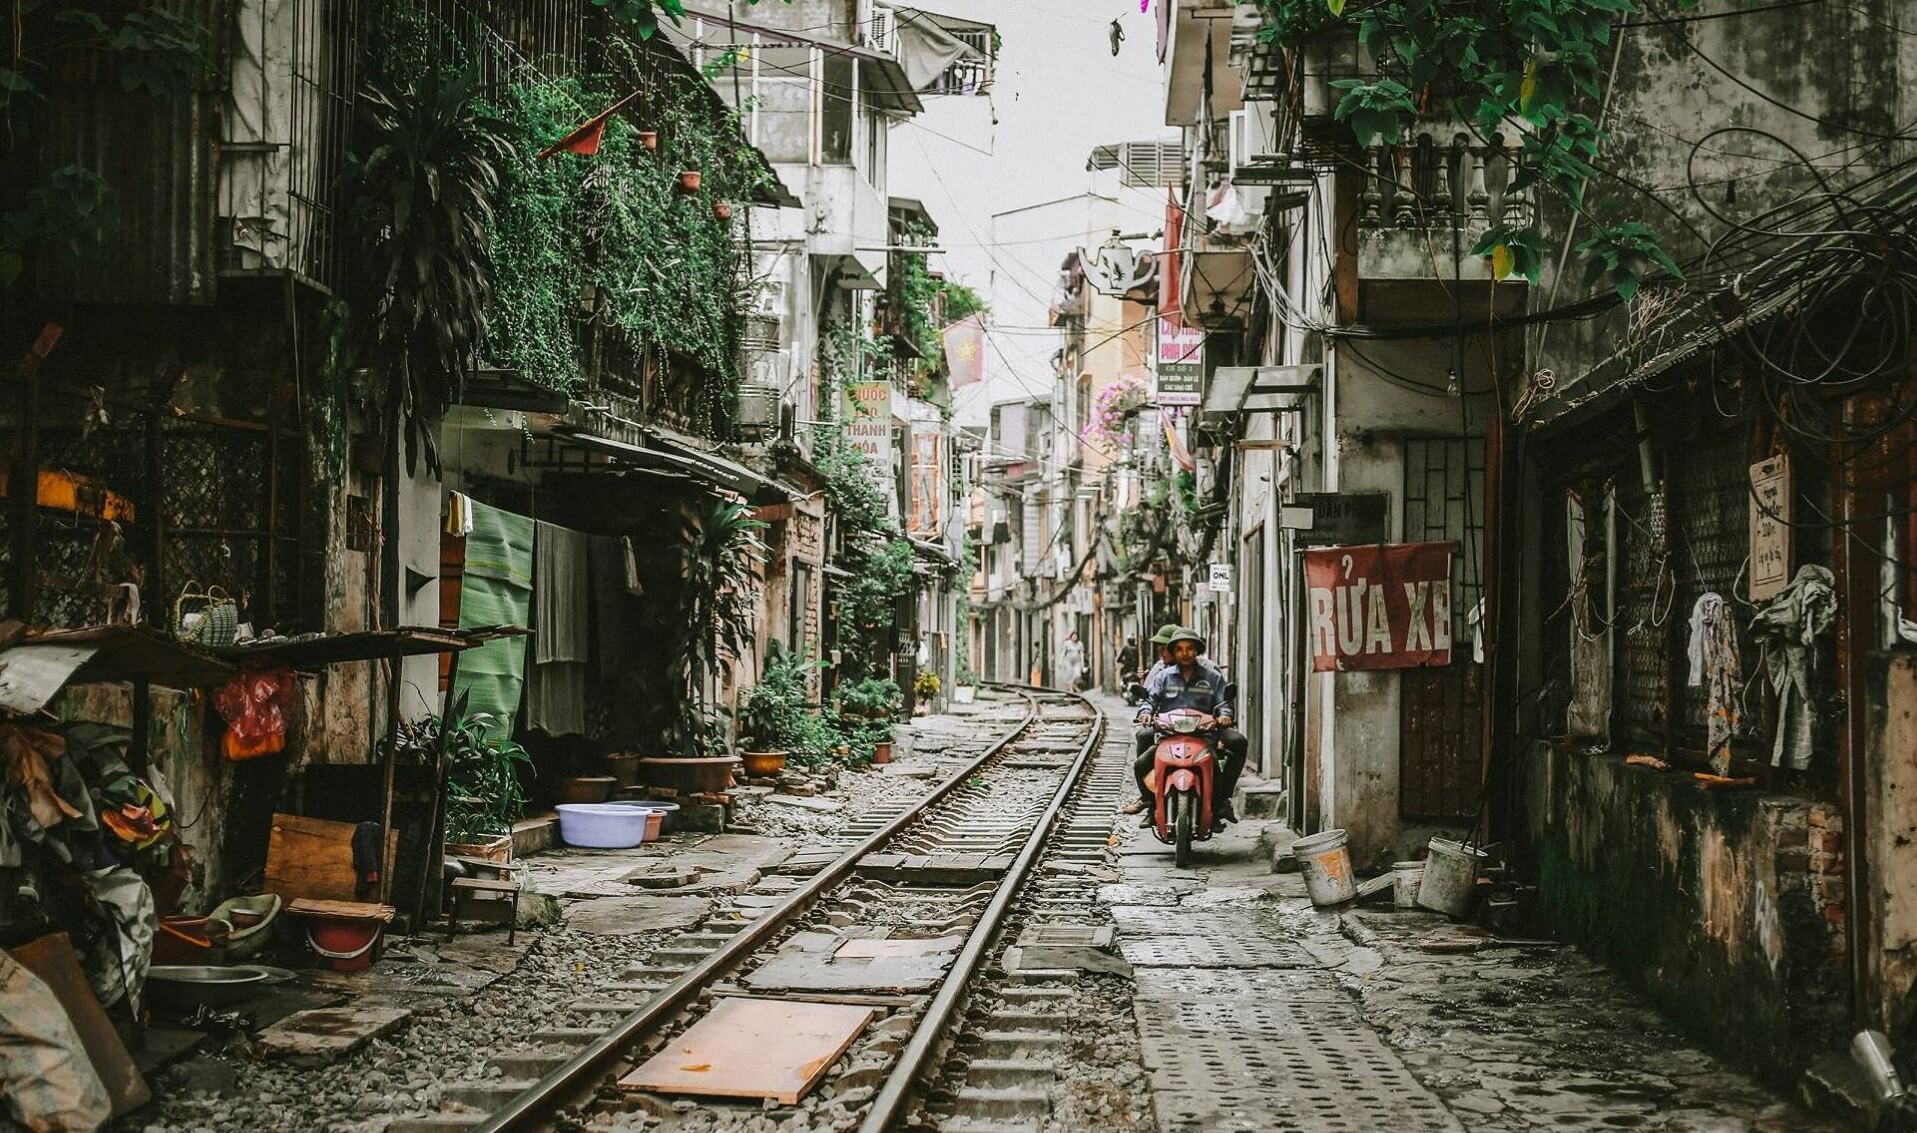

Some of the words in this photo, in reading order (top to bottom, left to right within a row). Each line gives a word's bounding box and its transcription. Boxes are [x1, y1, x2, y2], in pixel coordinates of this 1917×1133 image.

[847, 424, 886, 437] THANH
[1310, 554, 1393, 657] RỬA
[1404, 579, 1450, 652] XE
